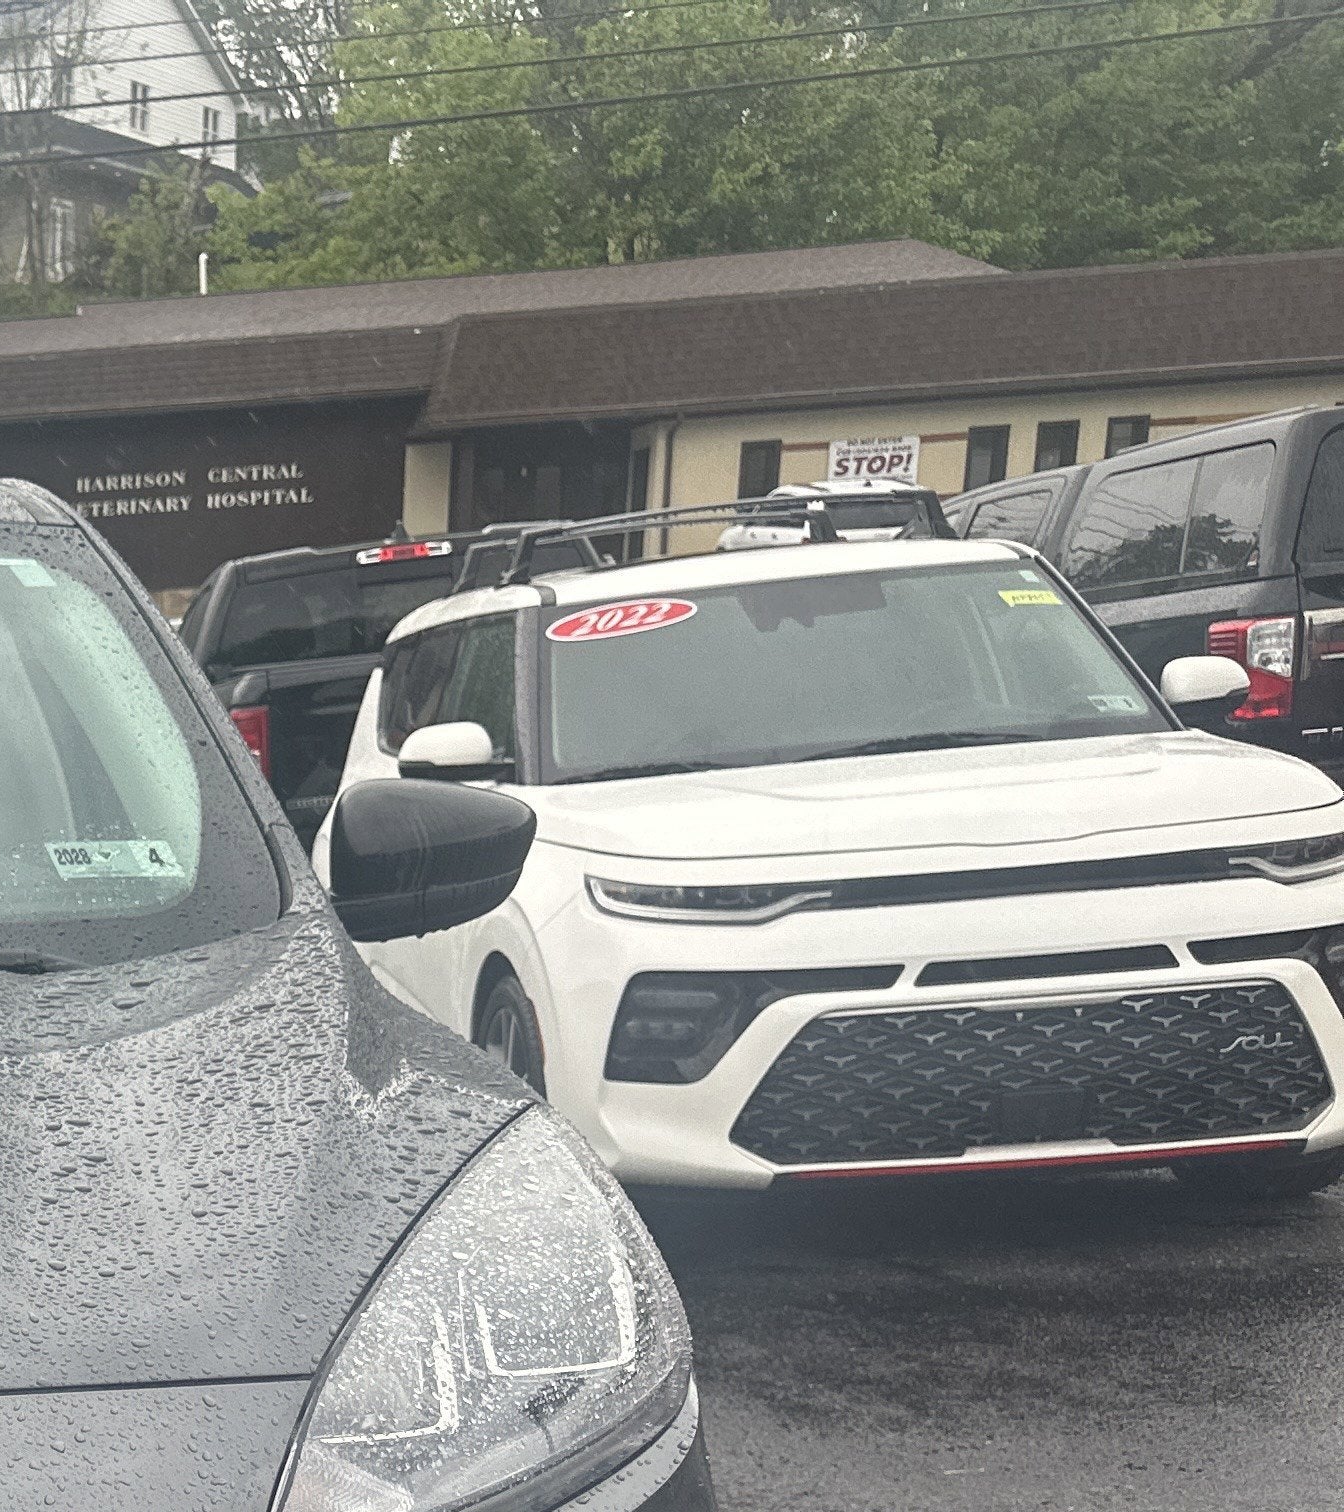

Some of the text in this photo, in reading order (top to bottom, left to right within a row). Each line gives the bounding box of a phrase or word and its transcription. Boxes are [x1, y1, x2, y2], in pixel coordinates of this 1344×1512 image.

[76, 462, 304, 493] HARRISON CENTRAL
[834, 453, 913, 477] STOP!
[71, 486, 315, 518] ETERINARY HOSPITAL
[570, 601, 672, 637] 2022
[54, 847, 166, 868] 2028 4
